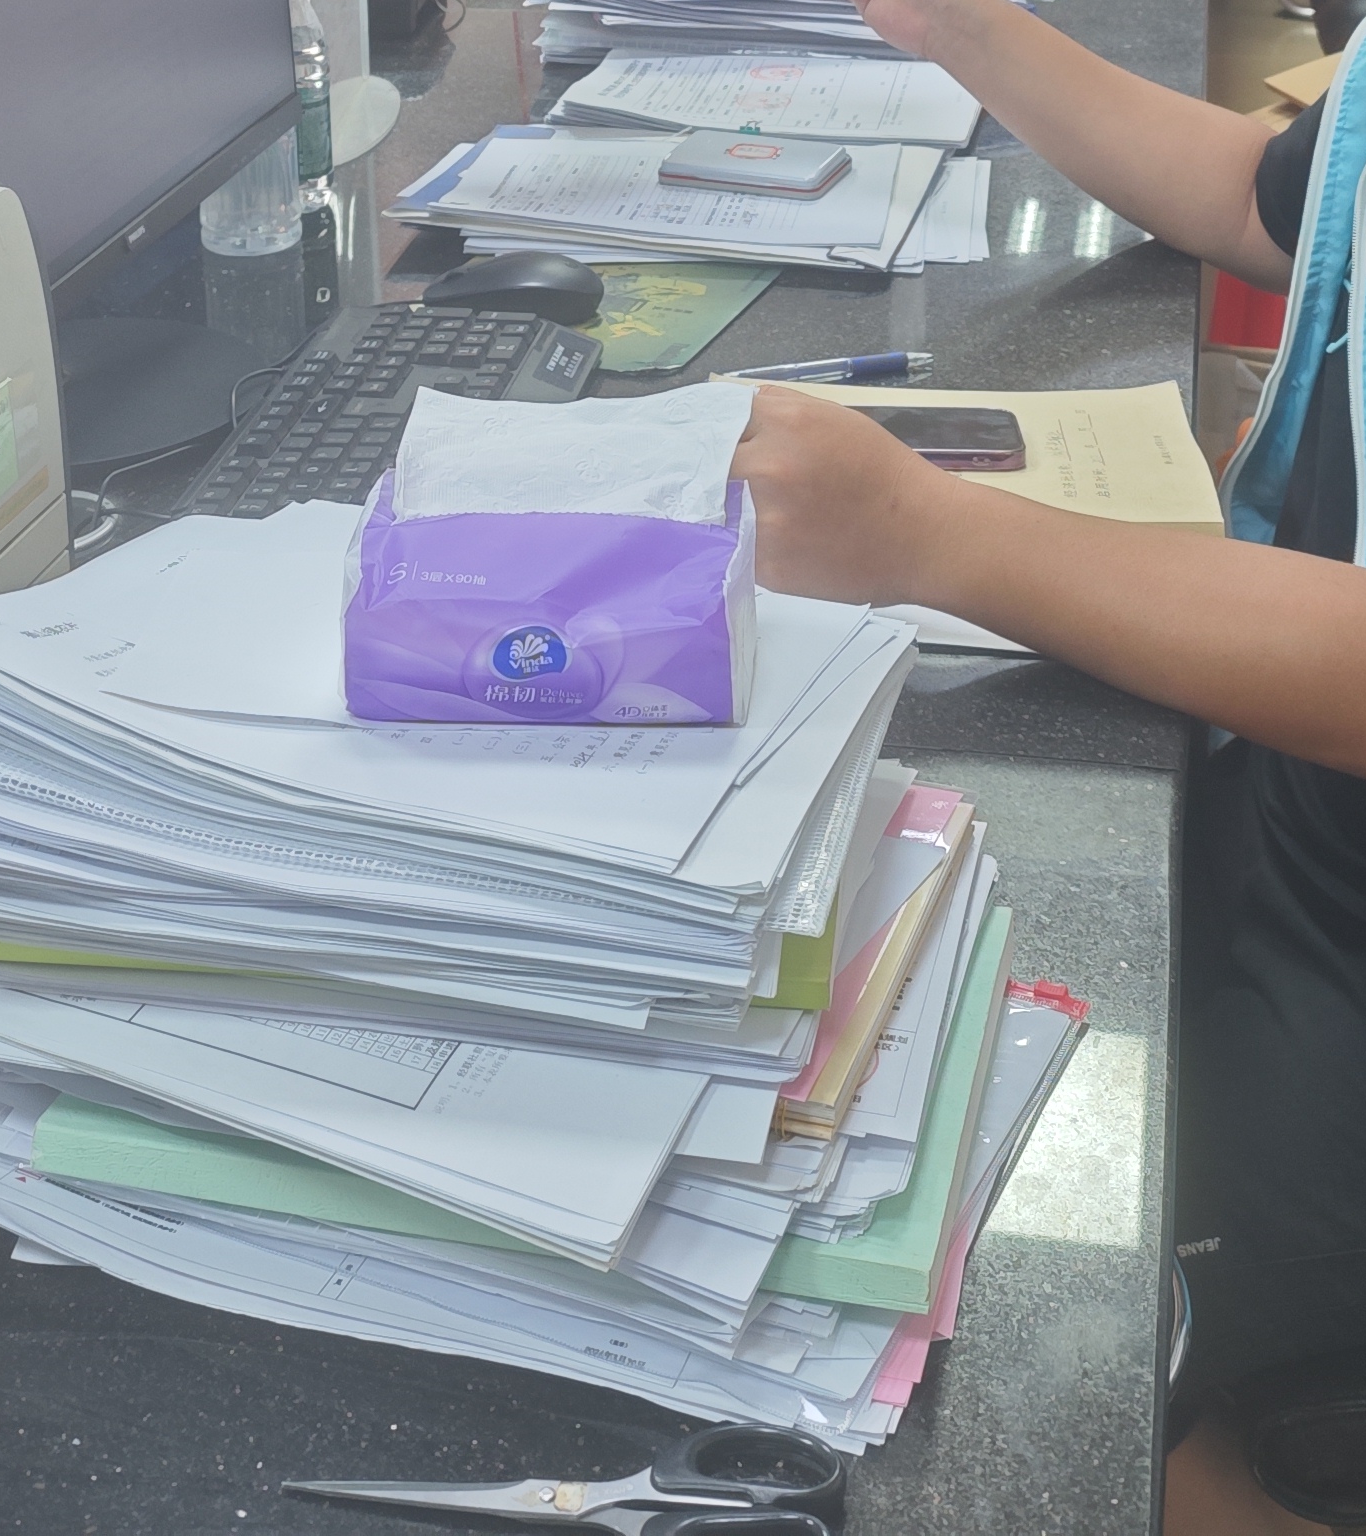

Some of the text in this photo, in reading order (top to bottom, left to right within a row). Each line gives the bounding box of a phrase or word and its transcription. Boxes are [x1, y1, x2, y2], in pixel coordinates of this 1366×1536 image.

[508, 655, 554, 670] Vinda
[484, 684, 536, 704] 棉韧
[539, 687, 584, 699] Deluxe
[614, 705, 642, 718] 4D
